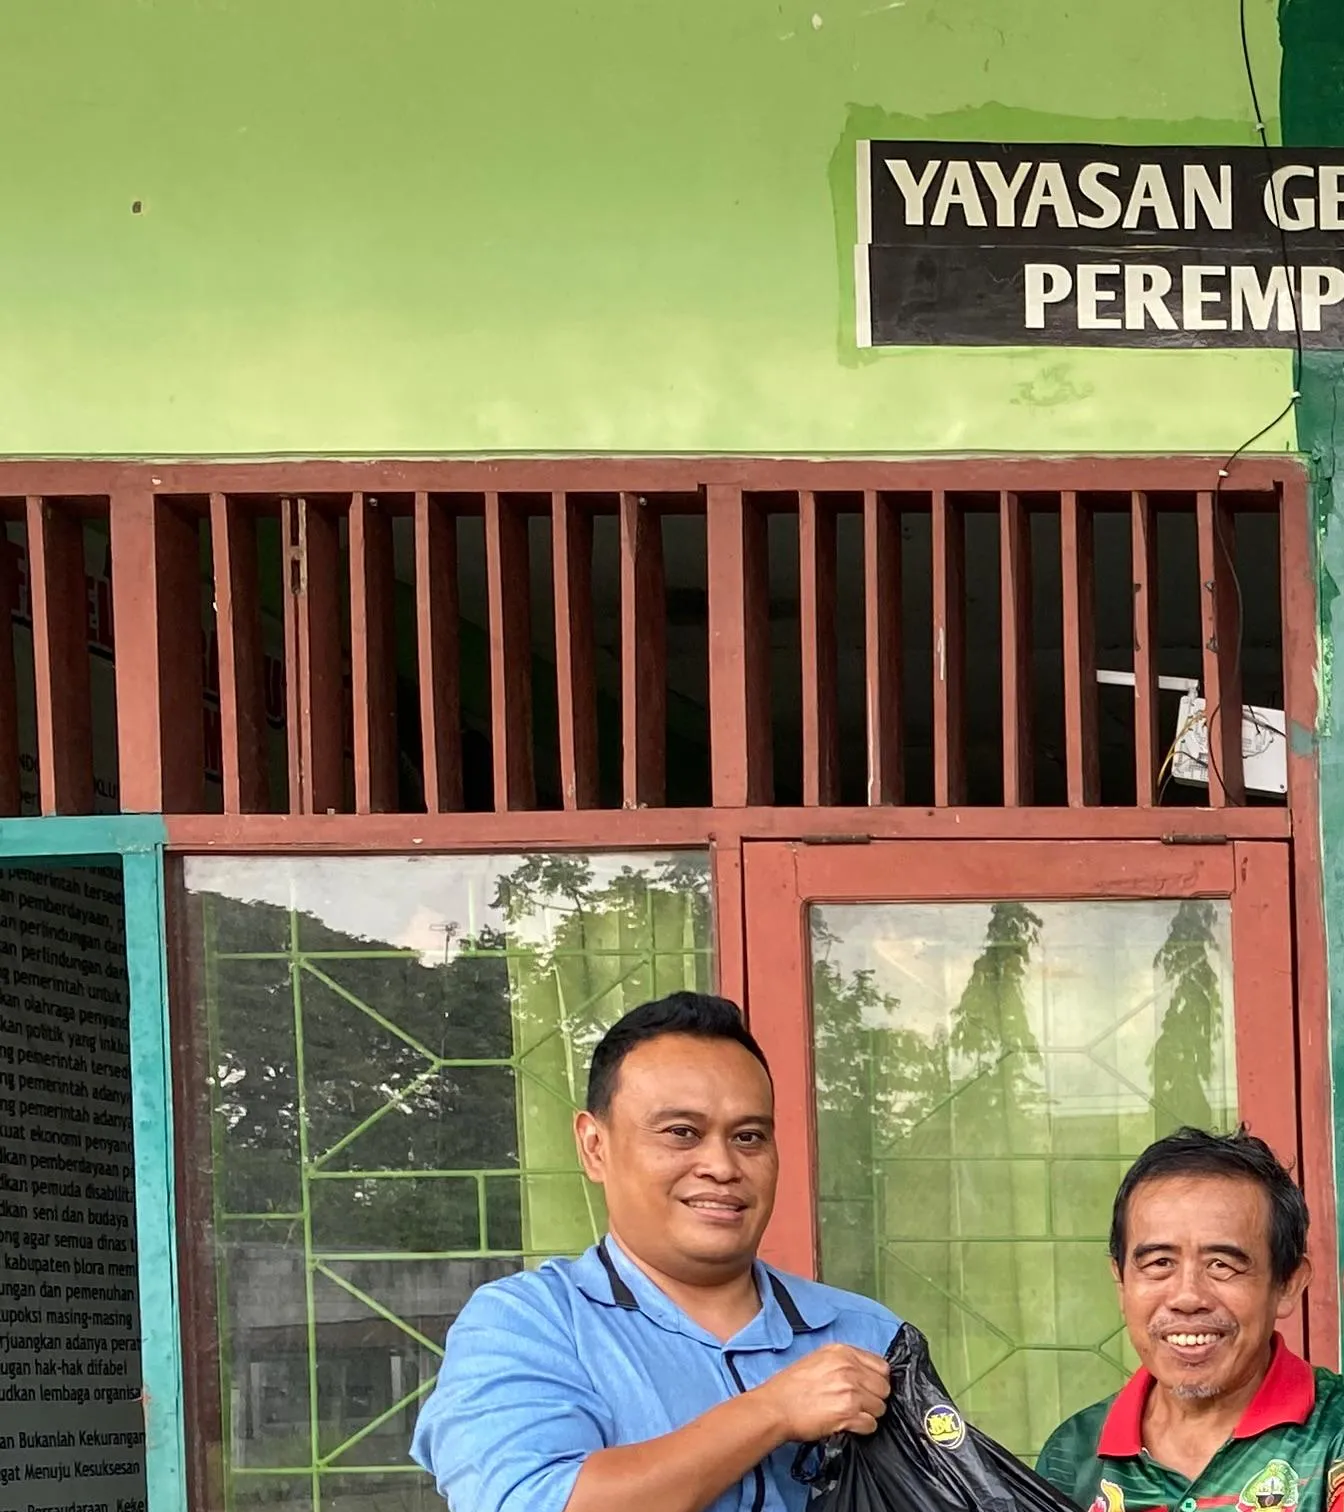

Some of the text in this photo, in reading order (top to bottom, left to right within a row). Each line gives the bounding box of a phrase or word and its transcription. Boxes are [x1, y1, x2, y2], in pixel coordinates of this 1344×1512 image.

[884, 159, 1233, 230] YAYASAN
[40, 1280, 62, 1299] dan
[66, 1284, 135, 1303] pemenuhan
[46, 1308, 133, 1330] masing-masing
[65, 1333, 108, 1354] adanya
[35, 1359, 84, 1377] hak-hak
[87, 1359, 128, 1376] difabel
[40, 1383, 90, 1405] lembaga
[19, 1430, 76, 1449] Bukanlah
[79, 1429, 145, 1449] Kekurangan
[25, 1462, 71, 1483] Menuju
[74, 1460, 141, 1478] Kesuksesan
